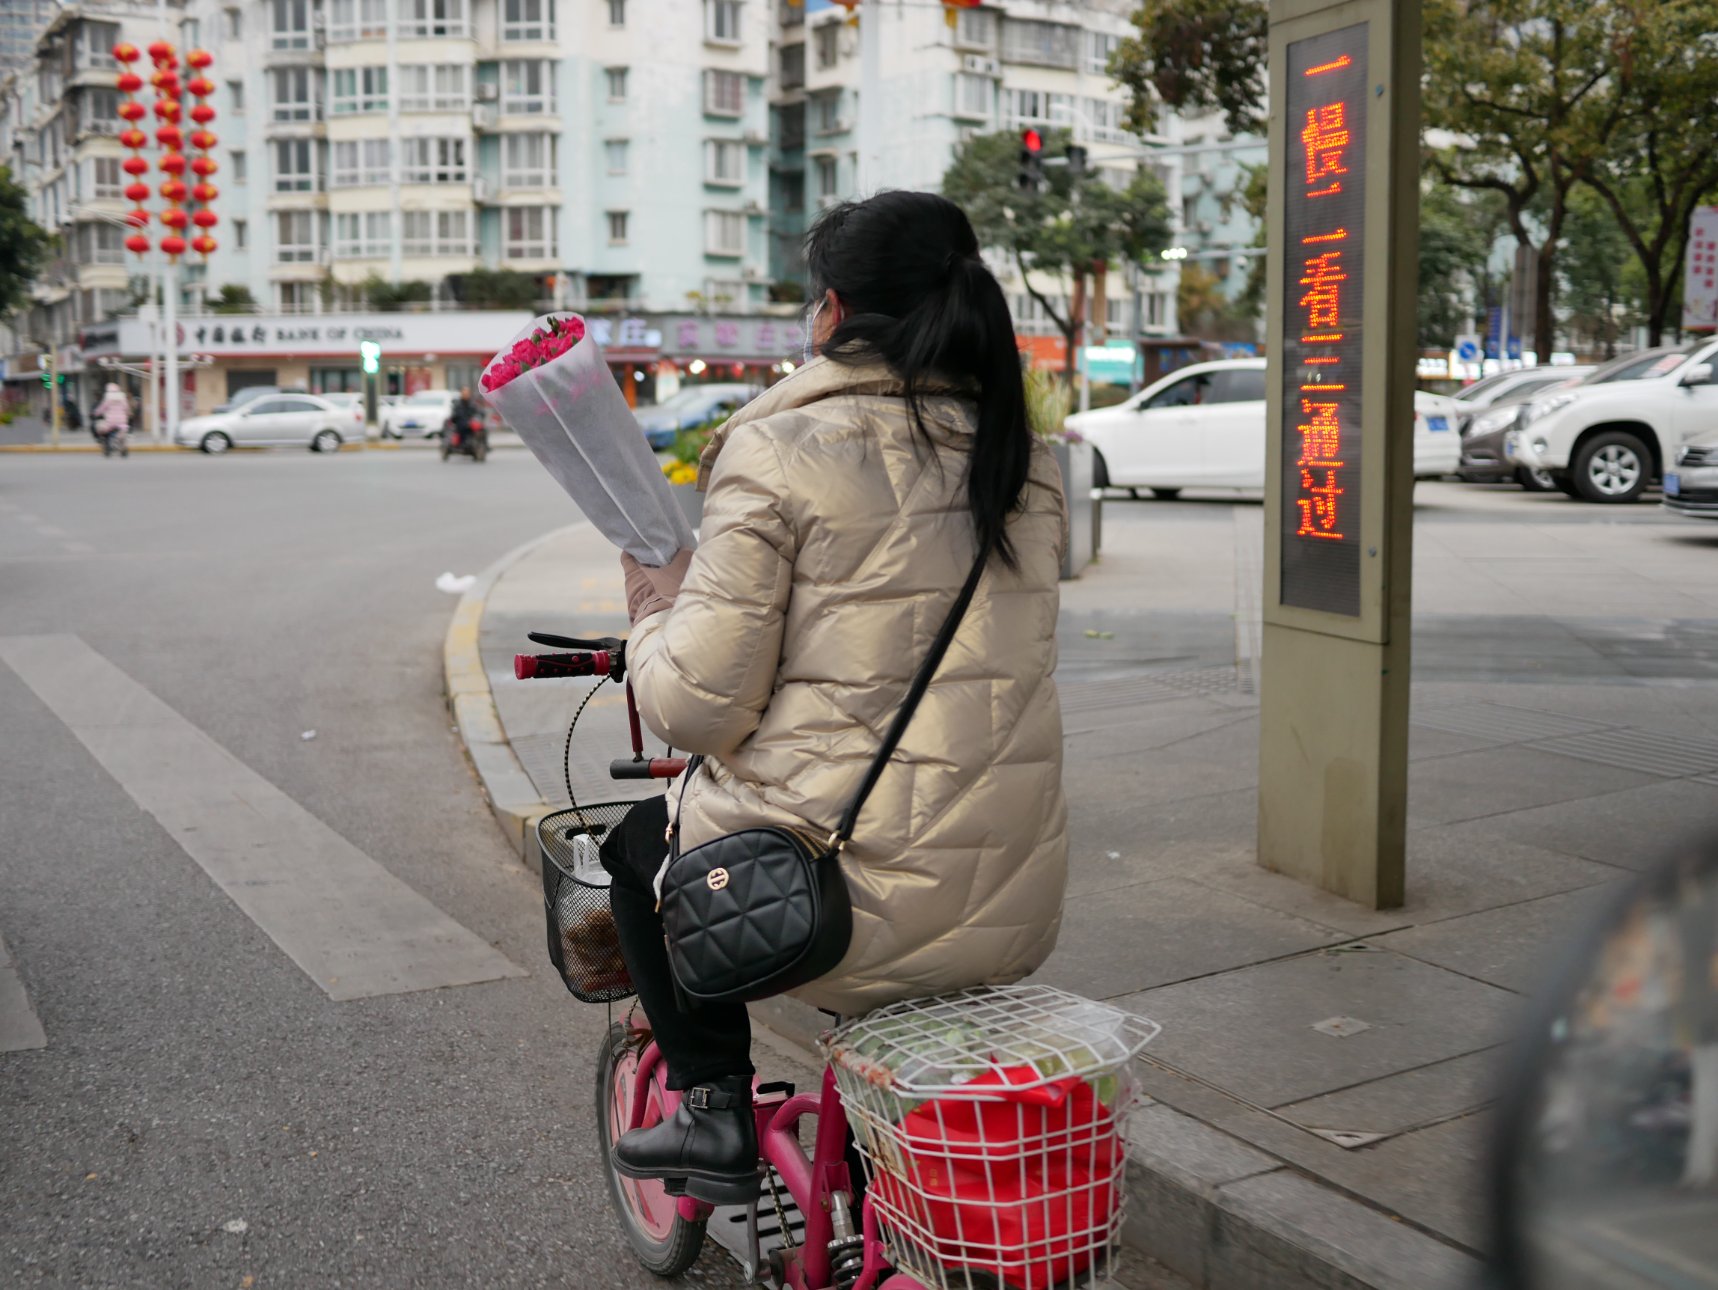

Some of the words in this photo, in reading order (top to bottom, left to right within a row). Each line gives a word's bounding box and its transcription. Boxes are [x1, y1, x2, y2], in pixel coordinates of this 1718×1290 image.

[276, 326, 320, 342] BANK
[326, 325, 347, 341] OF
[1297, 55, 1351, 539] 一慢二看三通过
